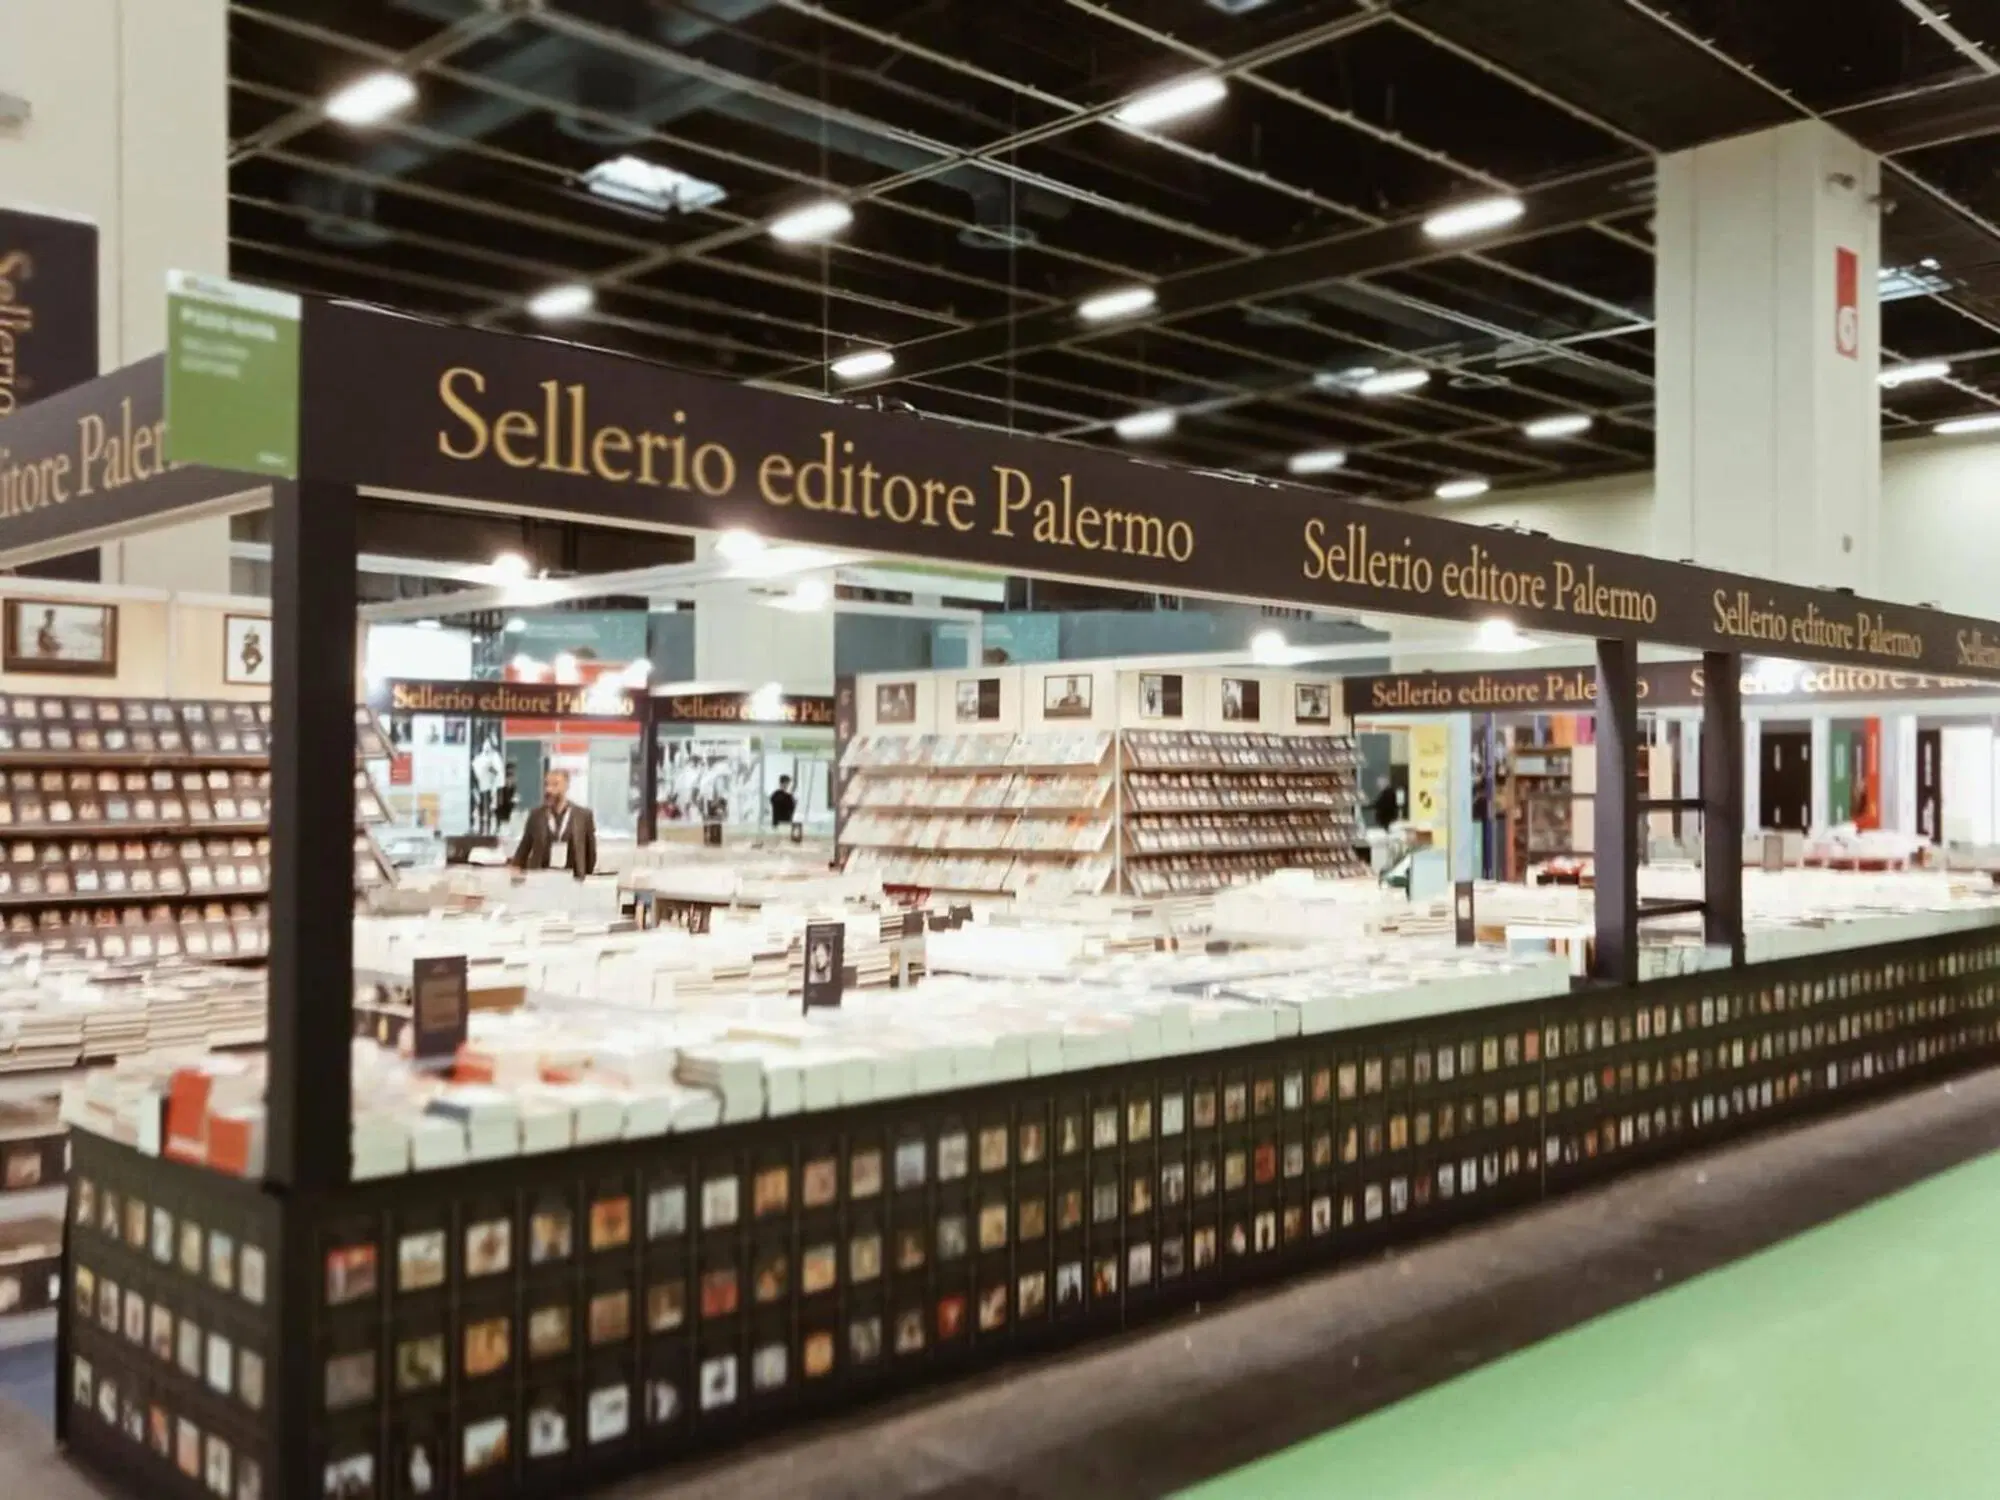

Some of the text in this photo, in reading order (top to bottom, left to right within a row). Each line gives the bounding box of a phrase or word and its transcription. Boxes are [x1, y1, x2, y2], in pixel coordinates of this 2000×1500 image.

[76, 396, 172, 497] Paler
[438, 366, 1195, 563] Sellerio editore Palermo
[1303, 518, 1657, 624] Sellerio editore Palermo
[1712, 588, 1923, 659] Sellerio editore Palermo
[392, 683, 635, 717] Sellerio editore Palo
[672, 696, 737, 720] Sellerio
[1371, 670, 1649, 706] Sellerio editore Paleo
